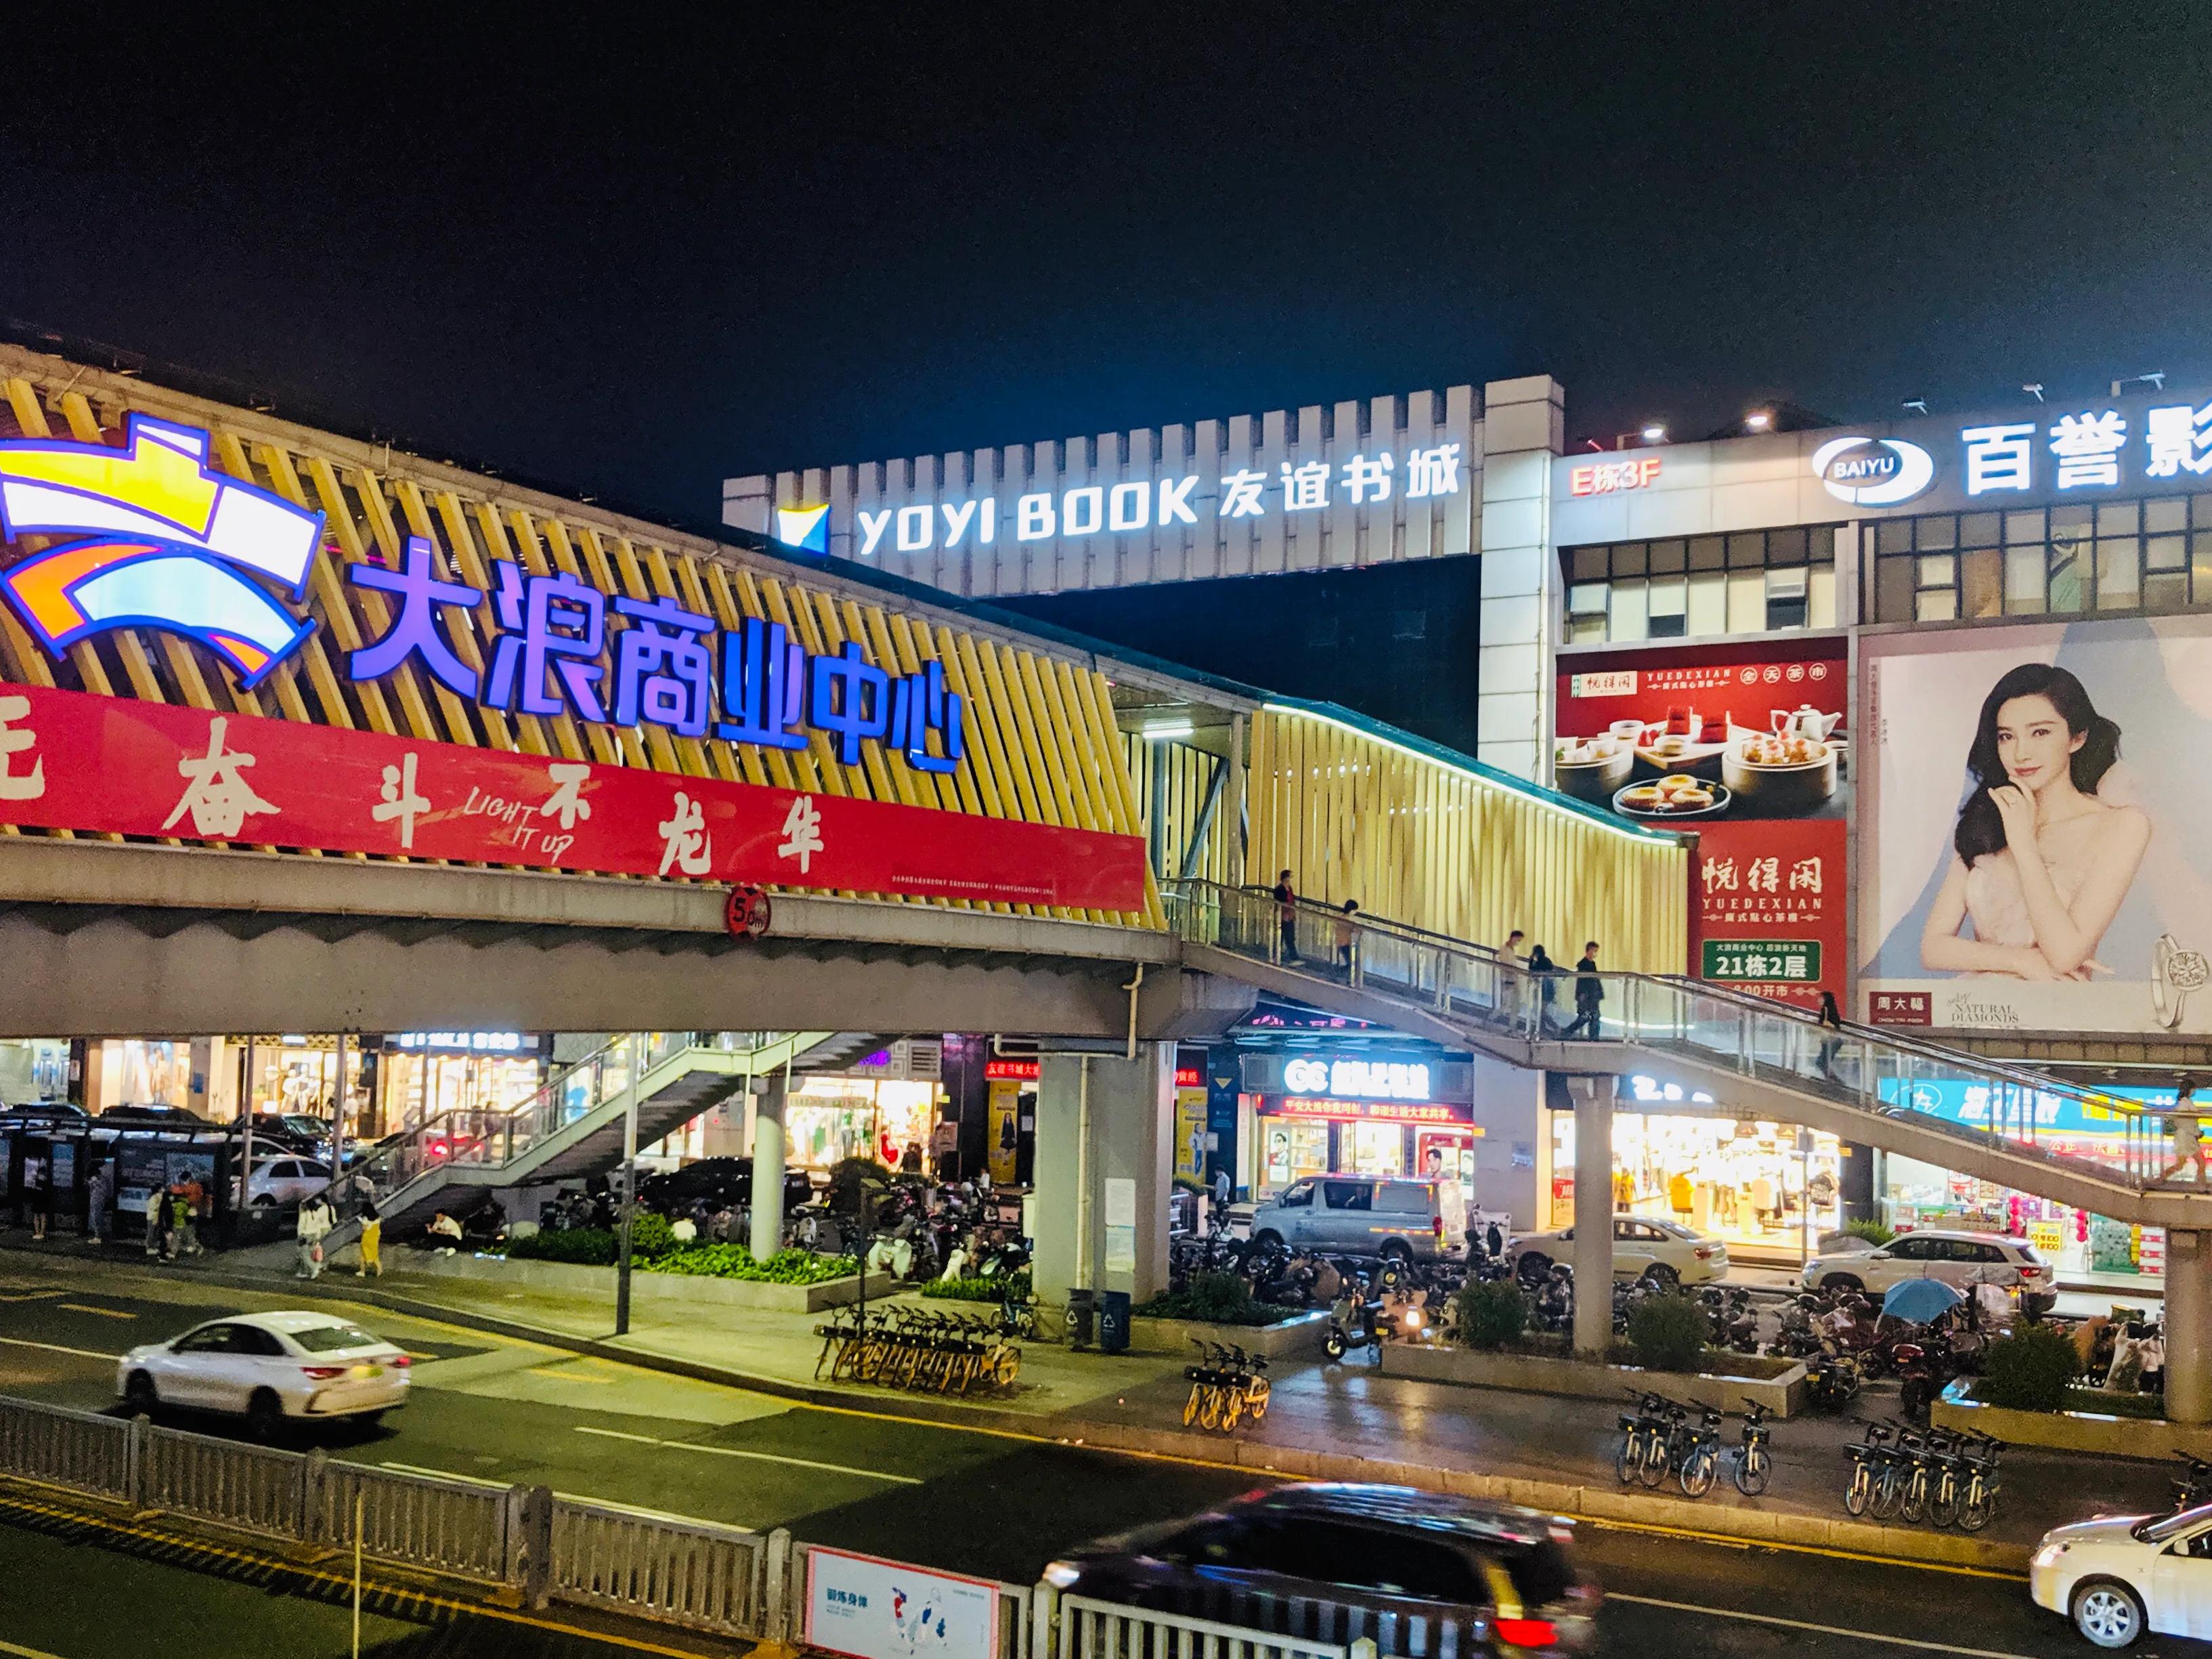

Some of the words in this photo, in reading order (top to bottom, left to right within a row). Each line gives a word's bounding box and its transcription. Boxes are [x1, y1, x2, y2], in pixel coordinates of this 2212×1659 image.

[1571, 458, 1661, 496] E栋3F
[1834, 456, 1894, 479] BAIYU
[1219, 443, 1460, 518] 友谊书城
[859, 497, 995, 555] YOYI
[1017, 475, 1200, 542] BOOK
[345, 535, 963, 774] 大浪商业中心
[1647, 669, 1731, 681] YUEDEXIAN
[1741, 664, 1826, 684] 全天茶市
[463, 785, 540, 825] LIGHT
[512, 824, 540, 850] IT
[541, 834, 574, 865] UP
[1701, 856, 1822, 894] 悦得闲
[1702, 898, 1822, 909] YUEDEXIAN
[1716, 955, 1807, 978] 21栋2层
[1878, 996, 1924, 1011] 周大福
[1955, 1004, 2015, 1014] NATURAL
[1951, 1013, 2019, 1023] DIAMONDS
